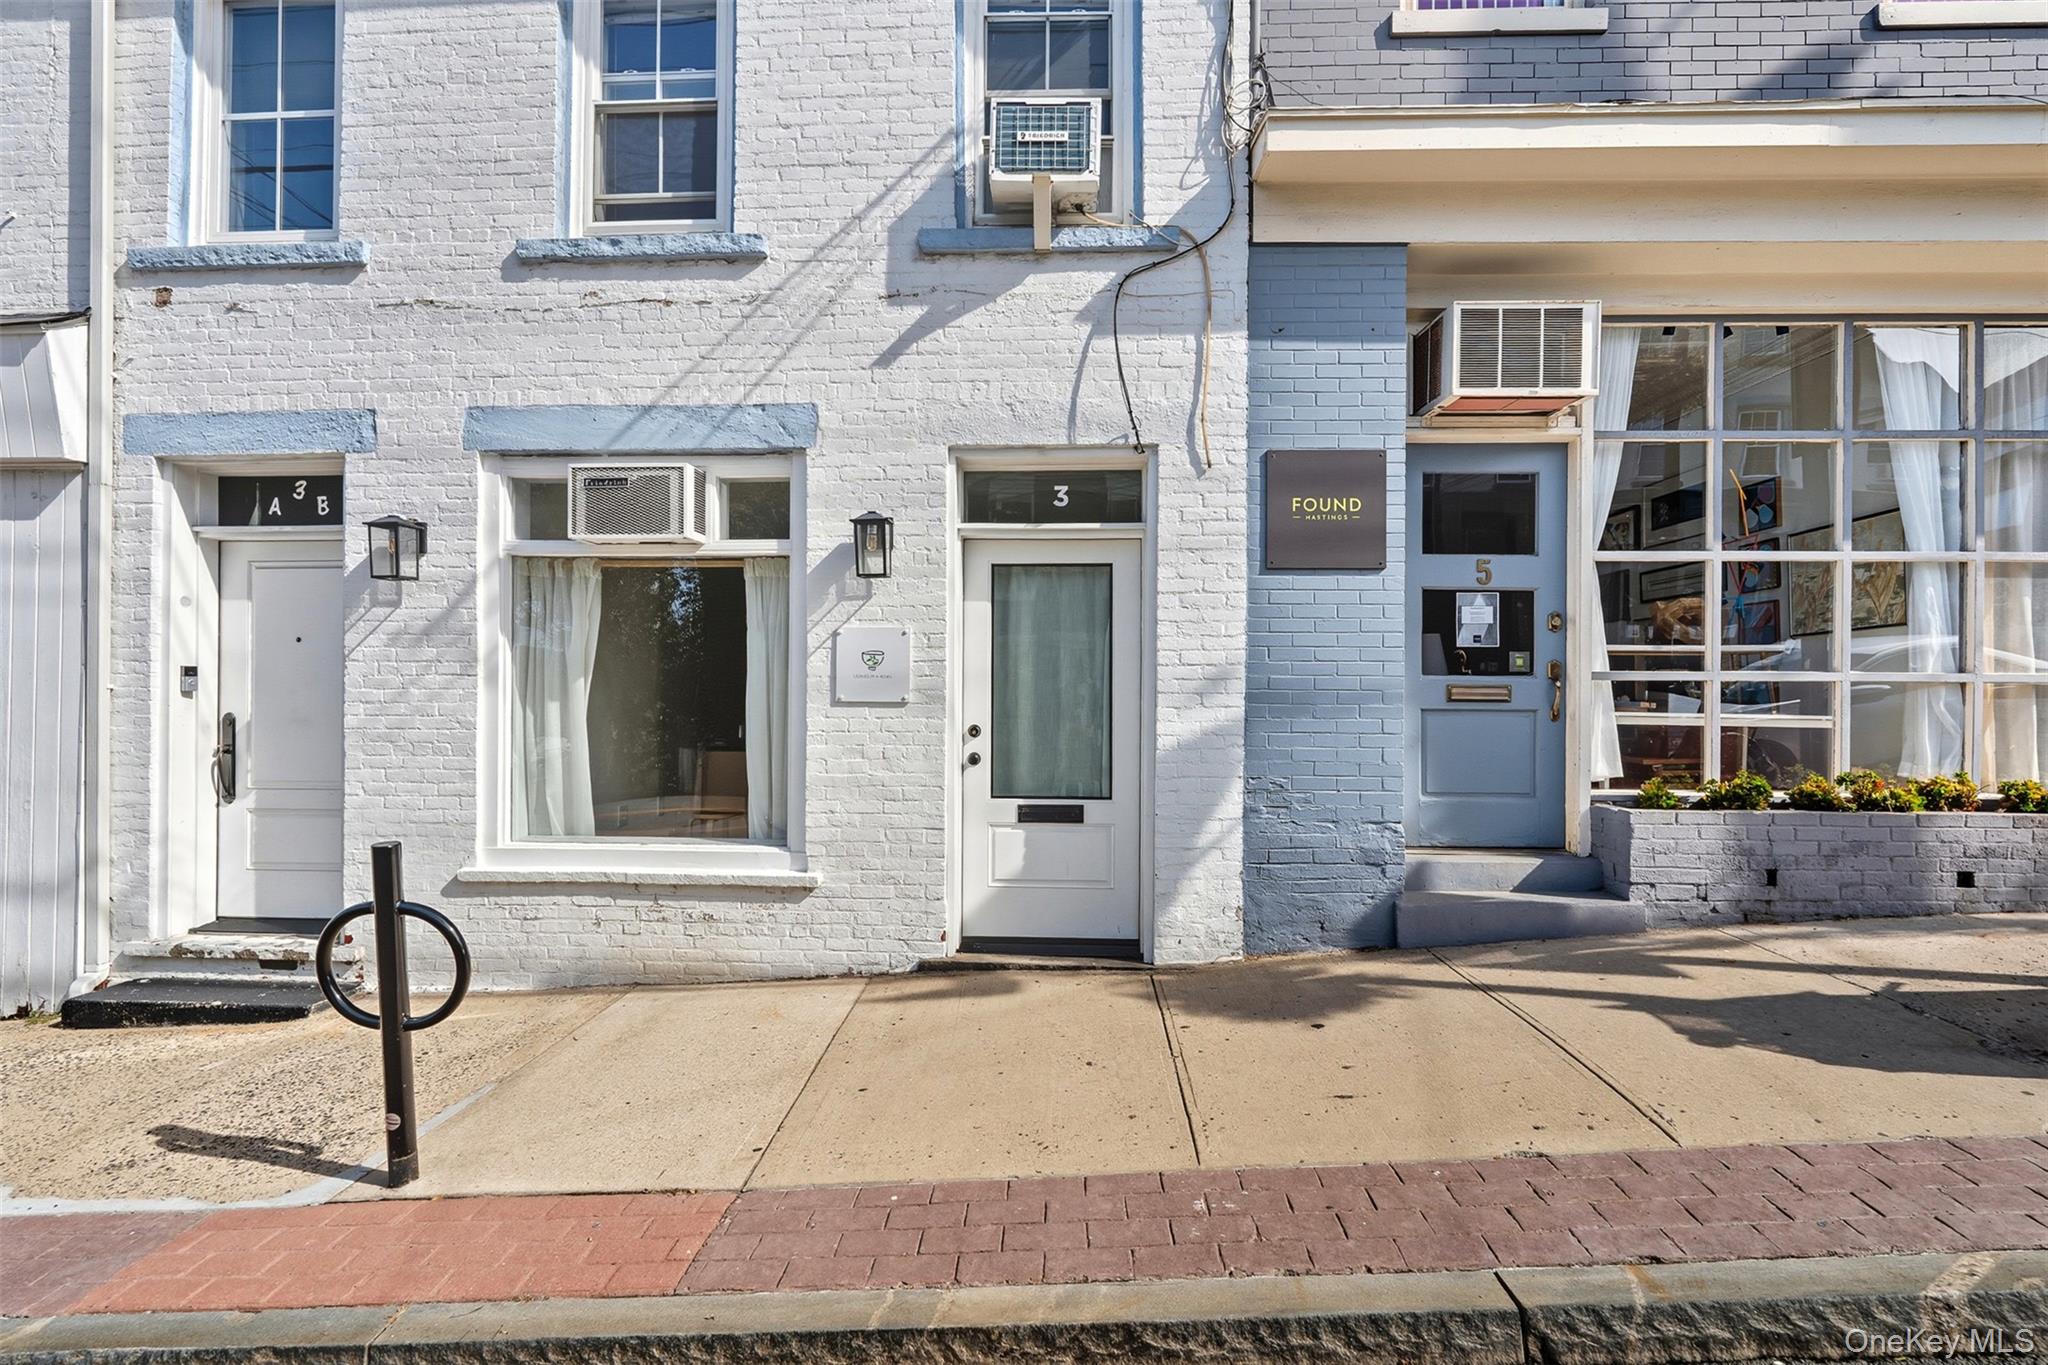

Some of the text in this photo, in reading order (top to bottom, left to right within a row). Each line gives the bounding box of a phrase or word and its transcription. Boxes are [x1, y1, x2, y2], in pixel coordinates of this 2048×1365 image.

[293, 480, 307, 499] 3
[1053, 485, 1069, 507] 3
[268, 496, 330, 515] A B
[1292, 497, 1361, 512] FOUND
[1476, 559, 1492, 585] 5
